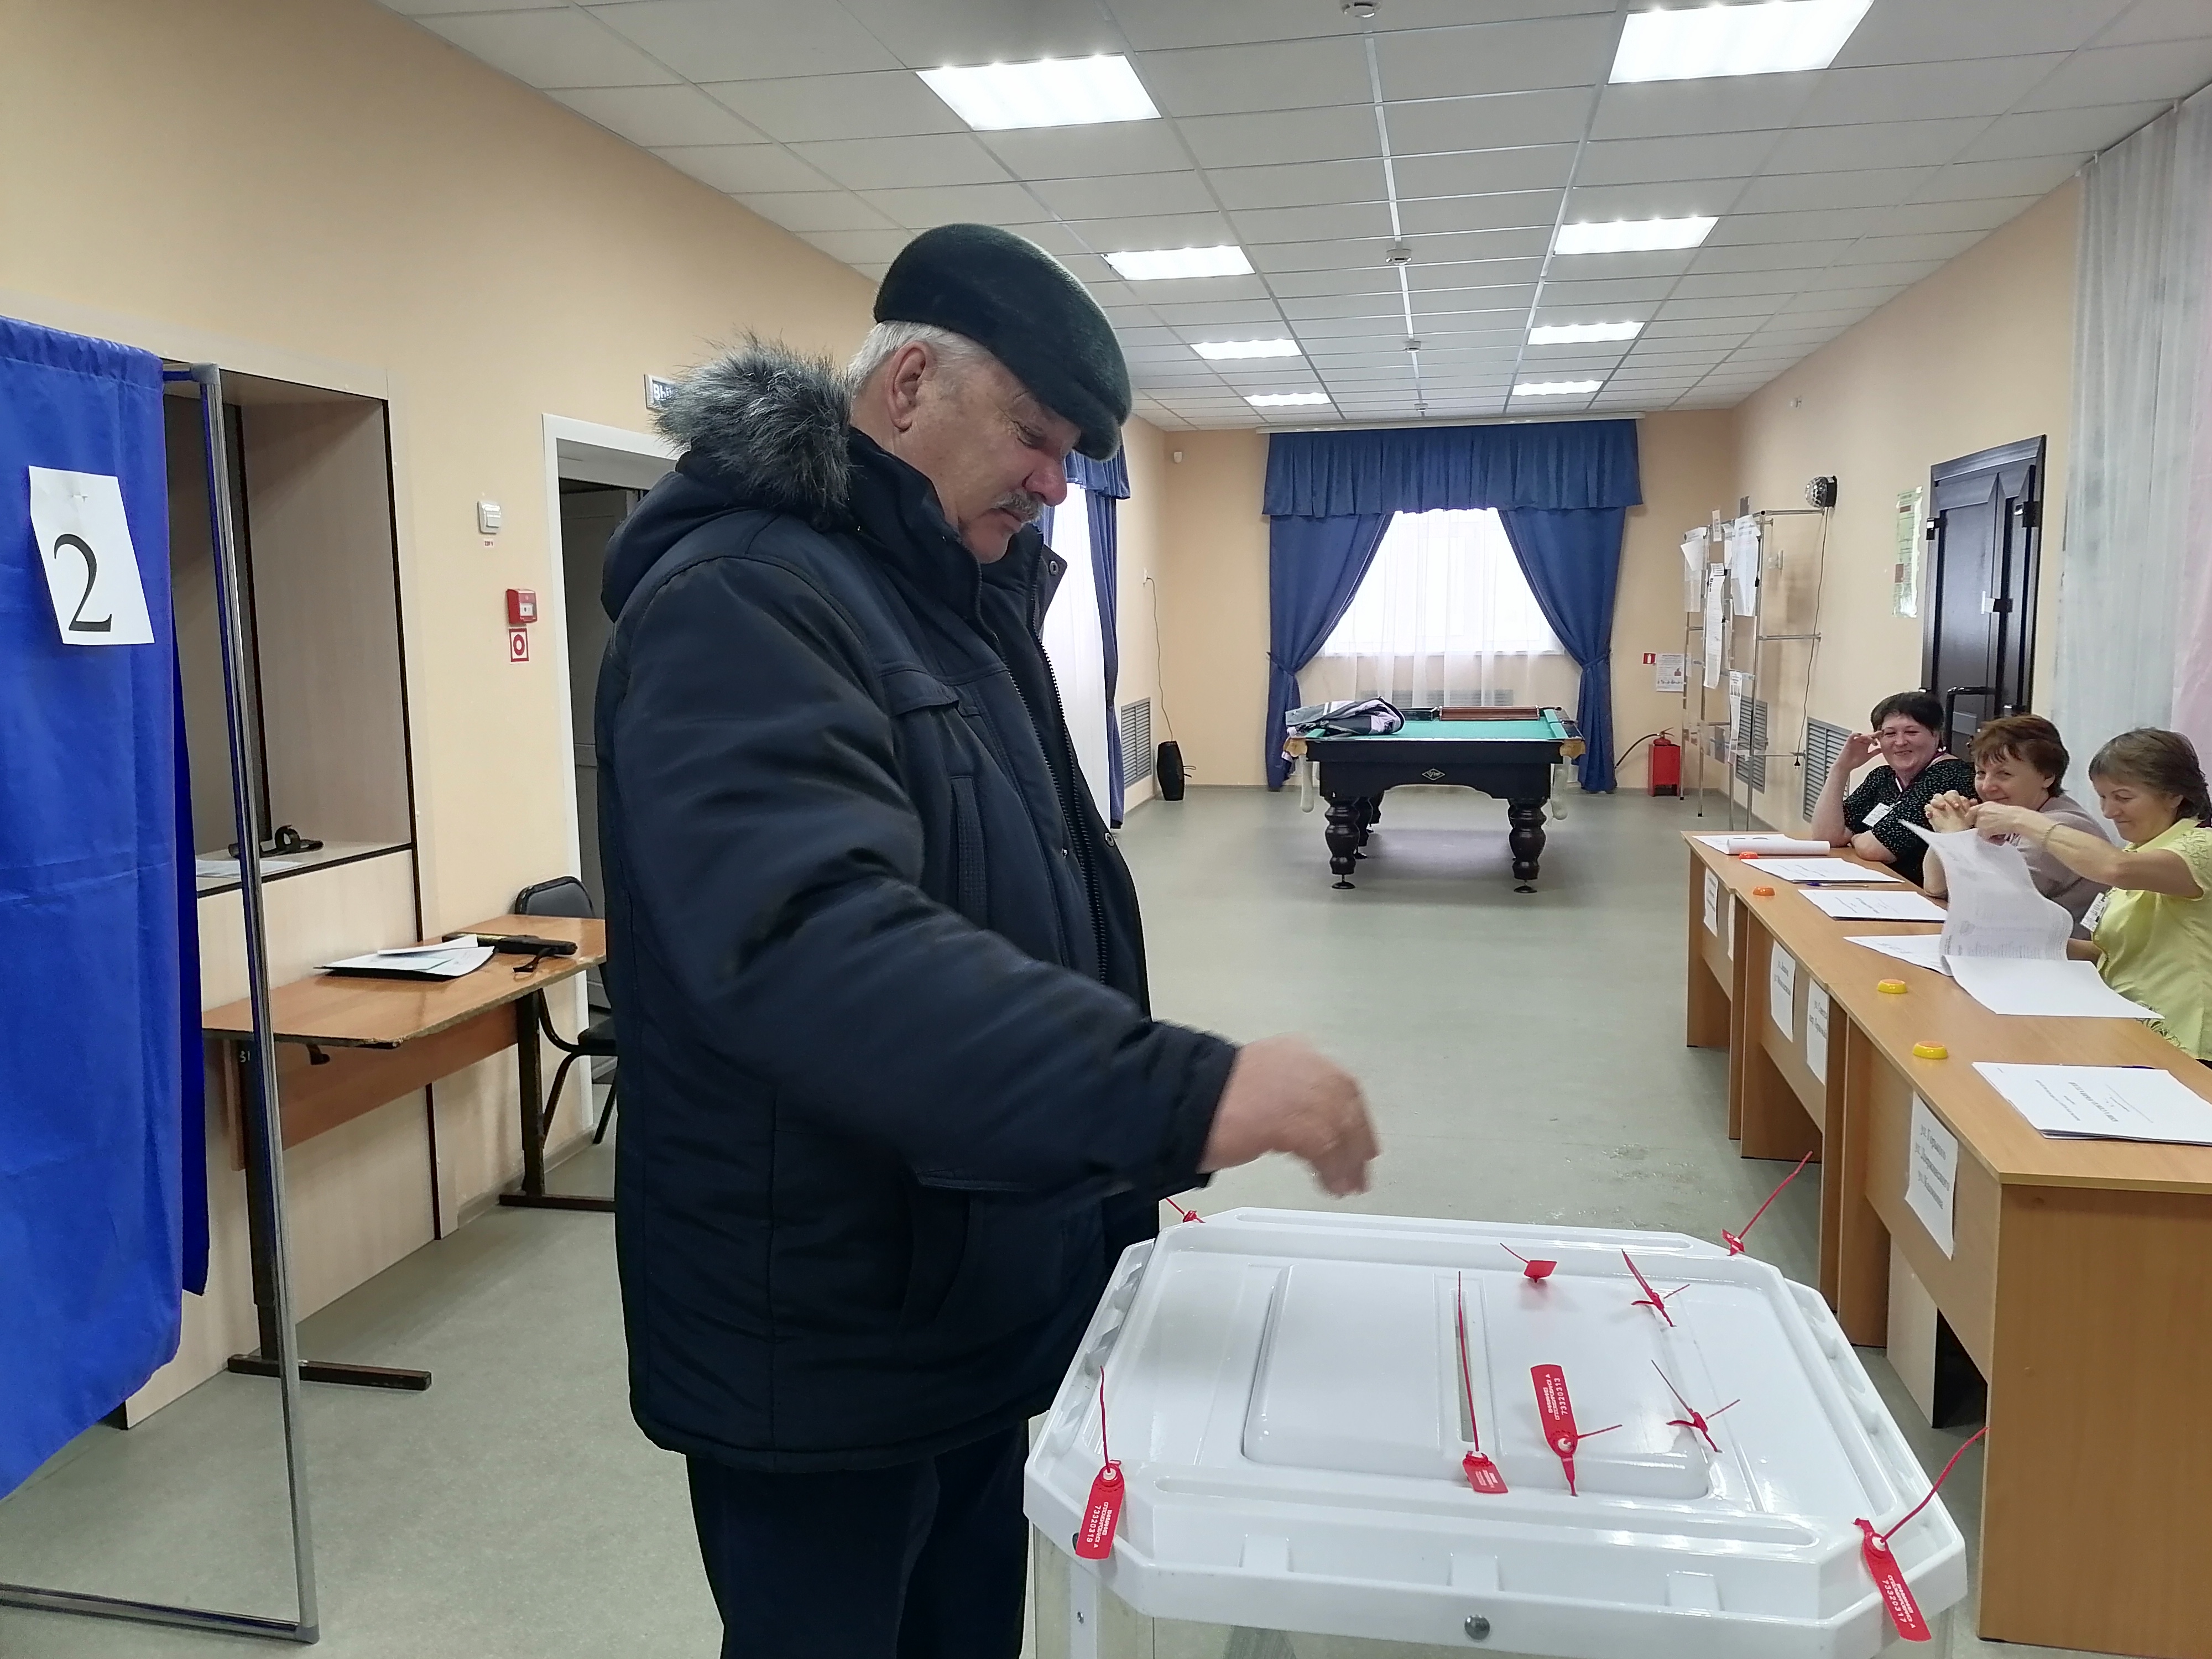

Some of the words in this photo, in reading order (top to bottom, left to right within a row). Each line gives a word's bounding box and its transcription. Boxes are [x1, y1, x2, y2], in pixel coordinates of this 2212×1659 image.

[53, 533, 113, 632] 2
[1554, 1378, 1568, 1415] 73320313
[1087, 1505, 1102, 1542] 73320319
[1882, 1580, 1907, 1622] 73320317
